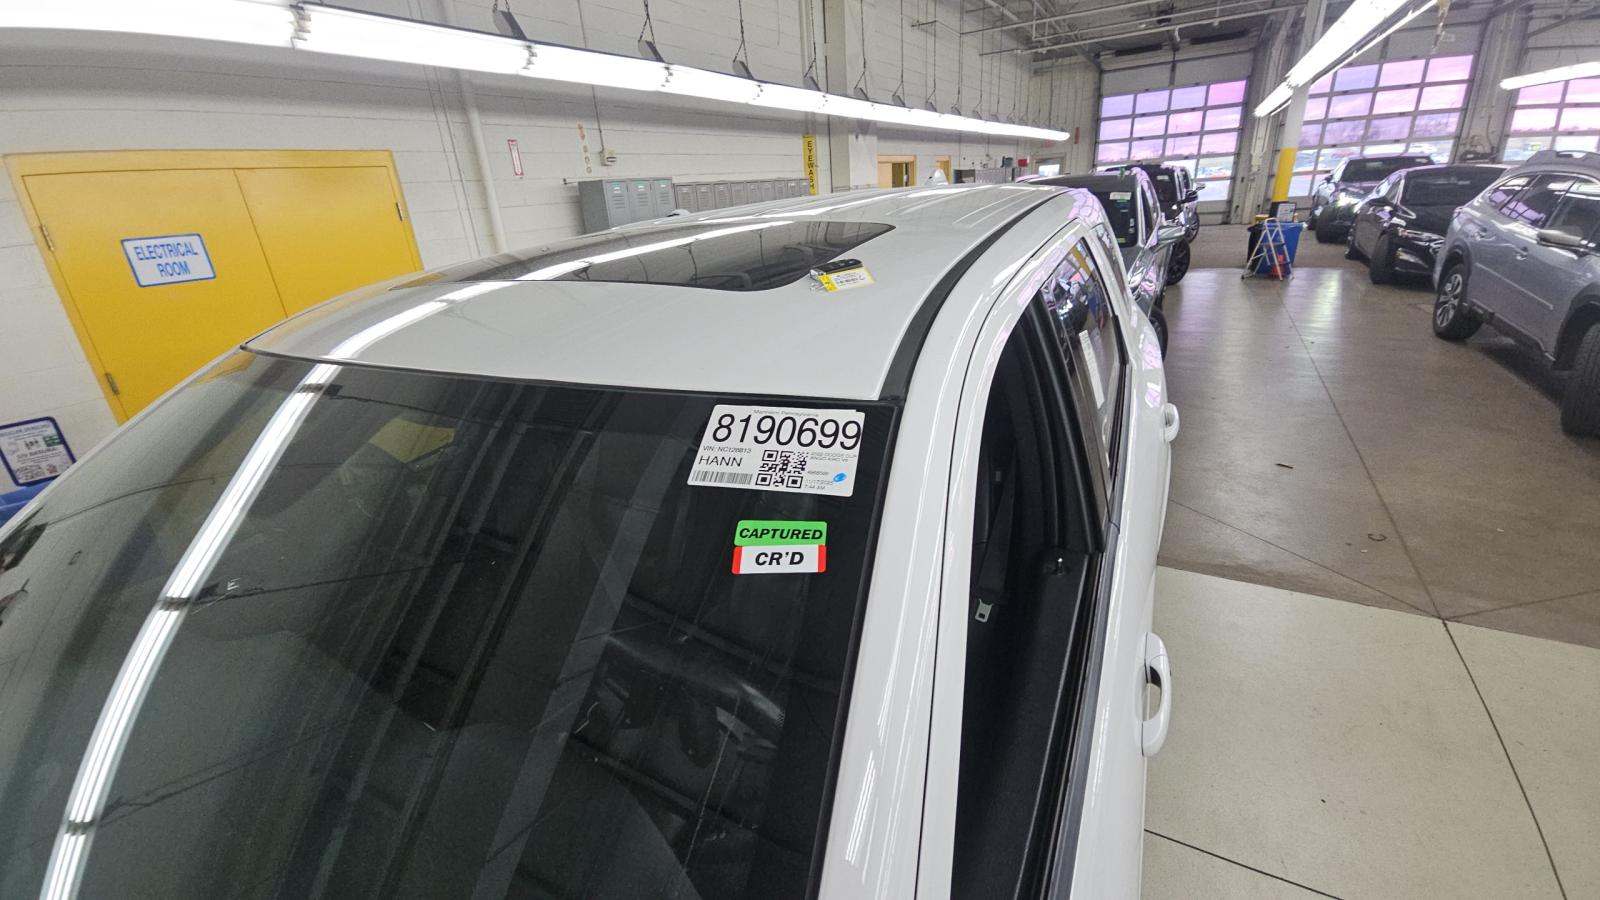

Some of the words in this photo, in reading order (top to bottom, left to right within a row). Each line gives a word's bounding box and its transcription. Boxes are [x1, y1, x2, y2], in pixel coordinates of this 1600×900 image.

[133, 242, 198, 260] ELECTRICAL
[156, 261, 191, 276] ROOM
[712, 413, 862, 451] 8190699
[698, 455, 743, 467] HANN
[739, 527, 823, 540] CAPTURED
[755, 552, 804, 566] CR'D
